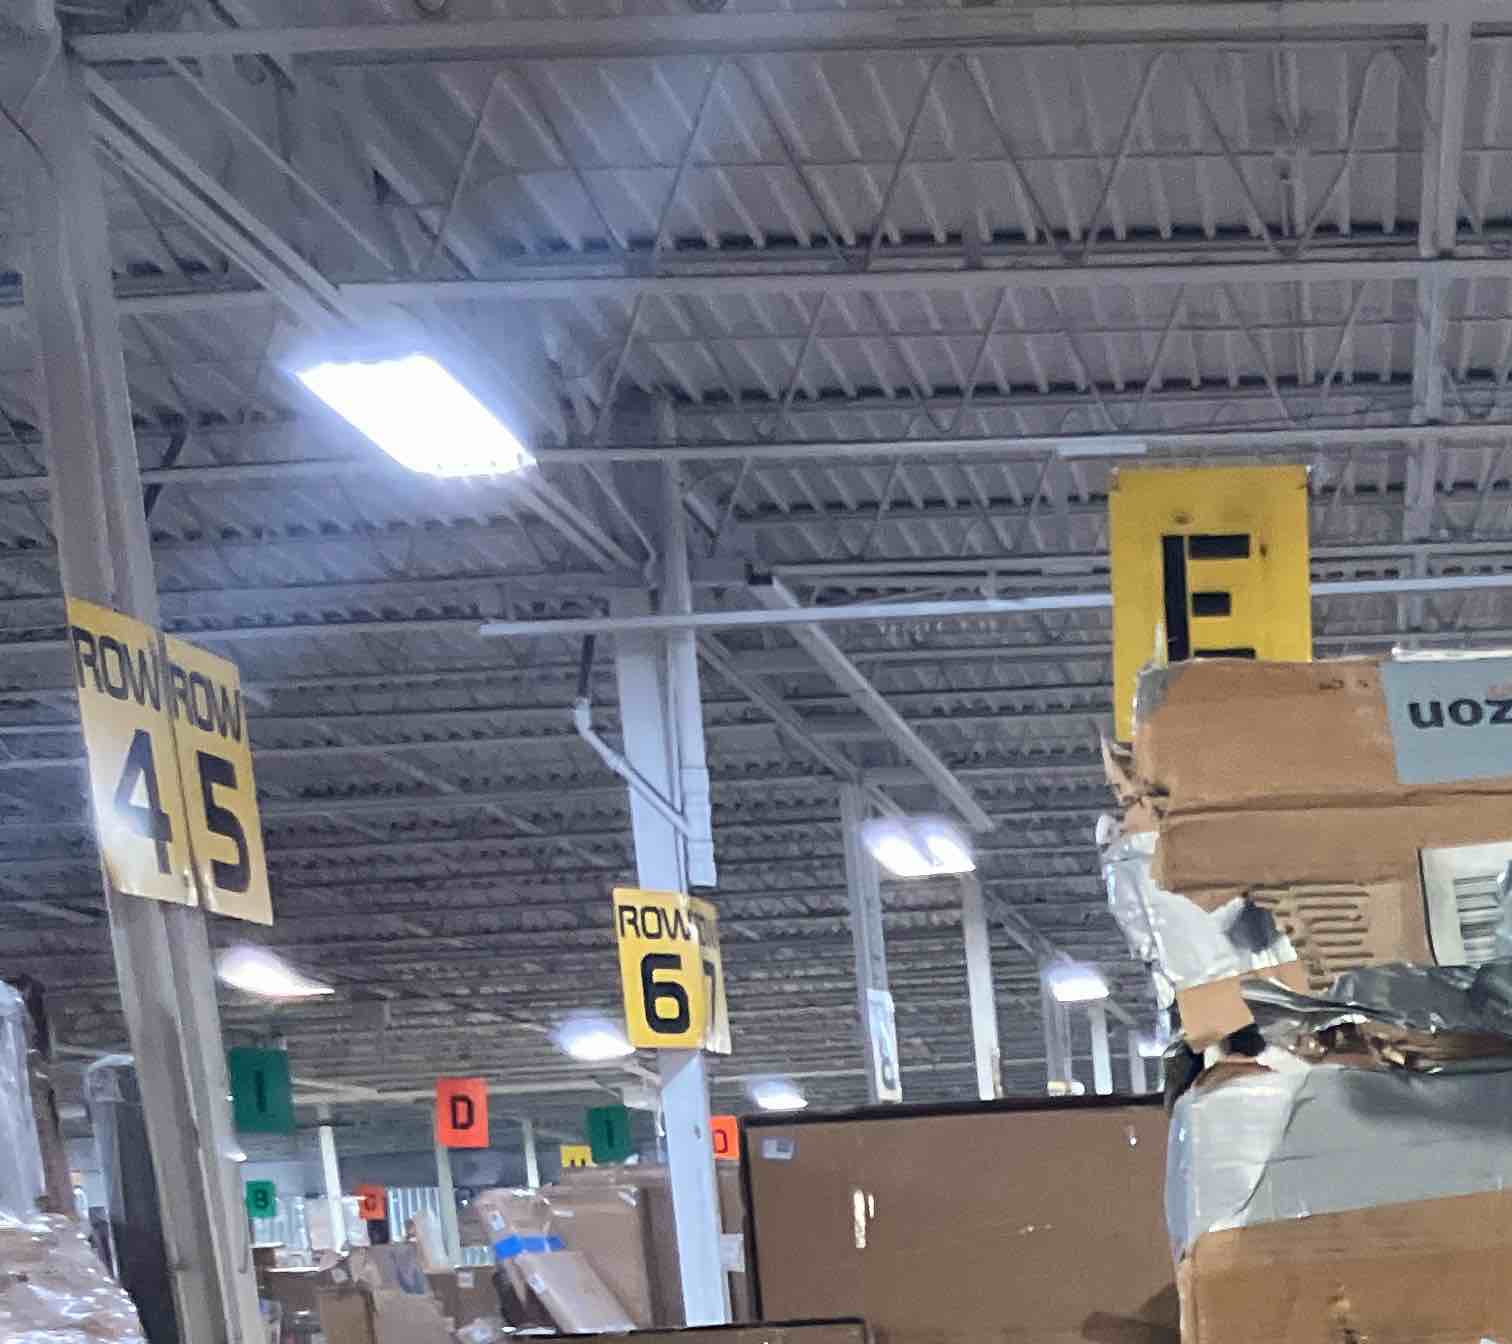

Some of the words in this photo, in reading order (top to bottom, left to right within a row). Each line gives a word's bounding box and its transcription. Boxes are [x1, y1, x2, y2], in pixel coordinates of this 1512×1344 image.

[1160, 533, 1256, 662] E
[71, 625, 161, 712] ROW
[168, 662, 243, 742] ROW
[113, 728, 172, 876] 4
[196, 749, 251, 893] 5
[618, 904, 691, 941] ROW
[640, 952, 690, 1034] 6
[450, 1094, 475, 1130] D
